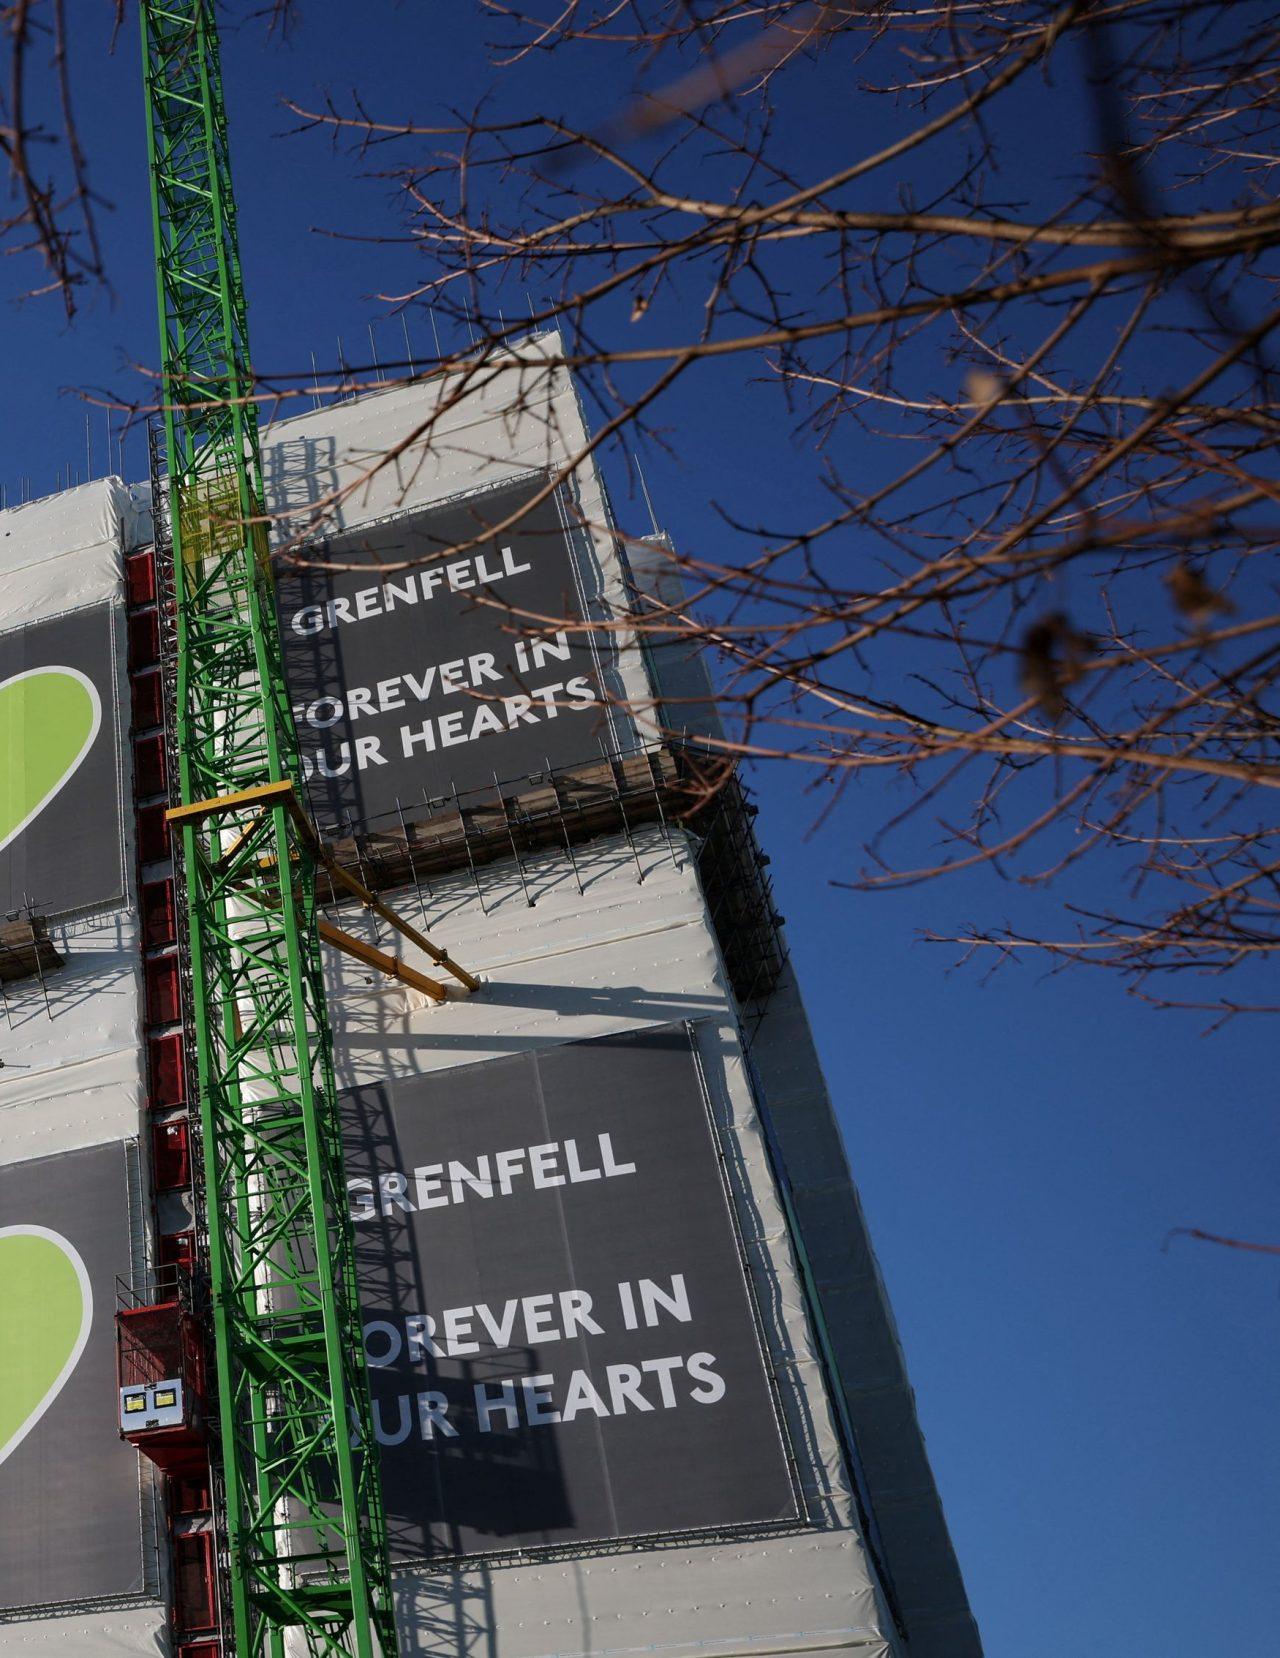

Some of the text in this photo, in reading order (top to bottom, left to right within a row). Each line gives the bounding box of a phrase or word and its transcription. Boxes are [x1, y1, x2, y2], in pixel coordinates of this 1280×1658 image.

[291, 547, 532, 636] GRENFELL
[514, 631, 572, 673] IN
[400, 675, 598, 757] HEARTS
[346, 1132, 637, 1222] GRENFELL
[363, 1273, 693, 1368] OREVER IN
[473, 1351, 727, 1433] HEARTS
